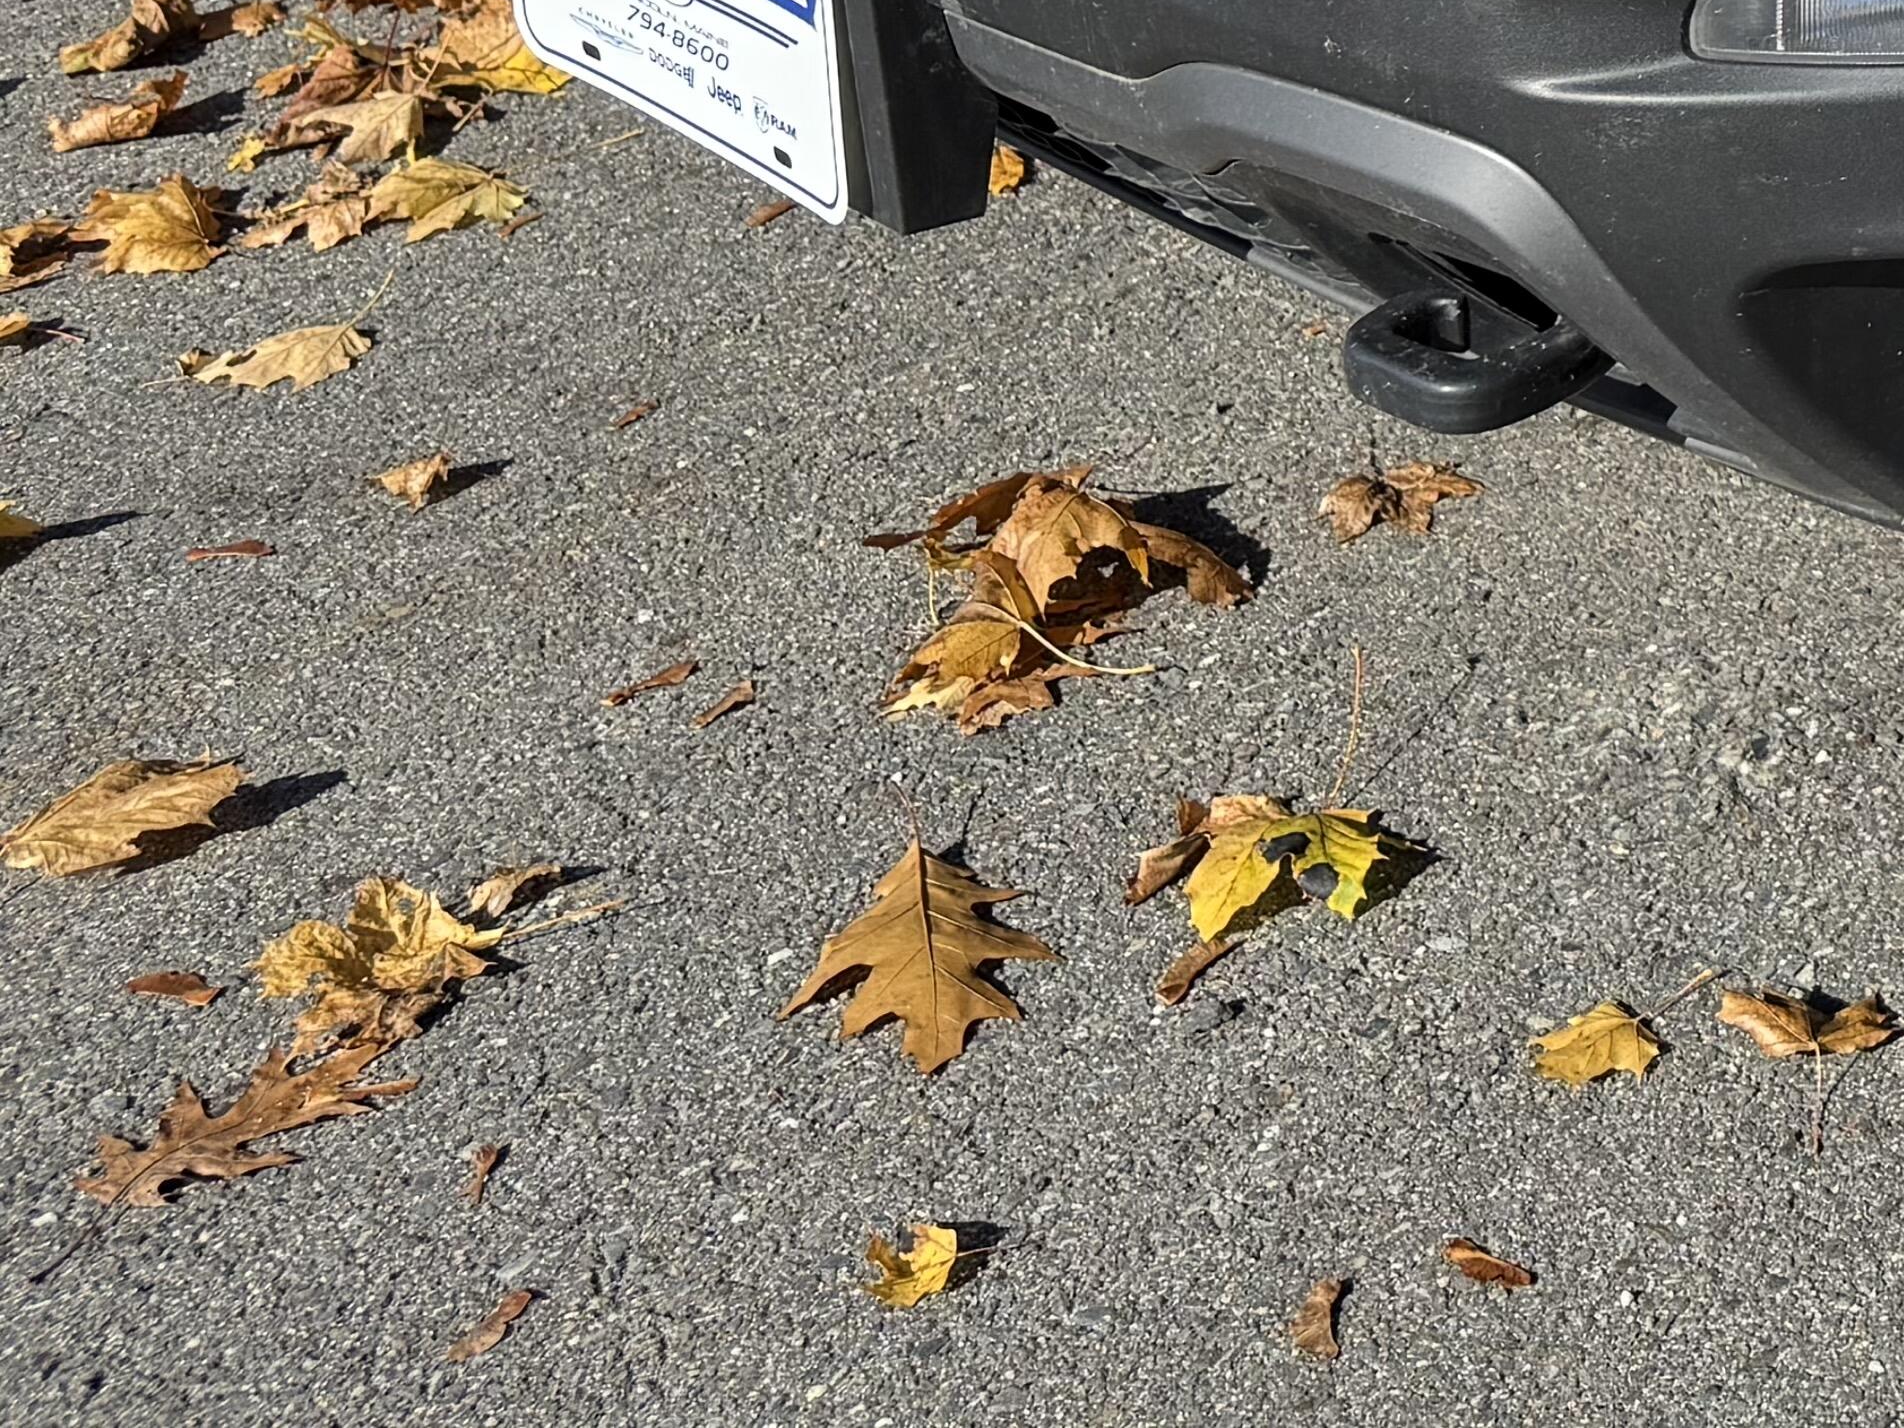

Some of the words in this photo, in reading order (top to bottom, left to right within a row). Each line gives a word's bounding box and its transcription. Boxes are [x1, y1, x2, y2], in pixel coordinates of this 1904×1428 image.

[626, 4, 730, 72] 794-8600
[707, 75, 742, 115] Jeep
[770, 114, 798, 140] RAM
